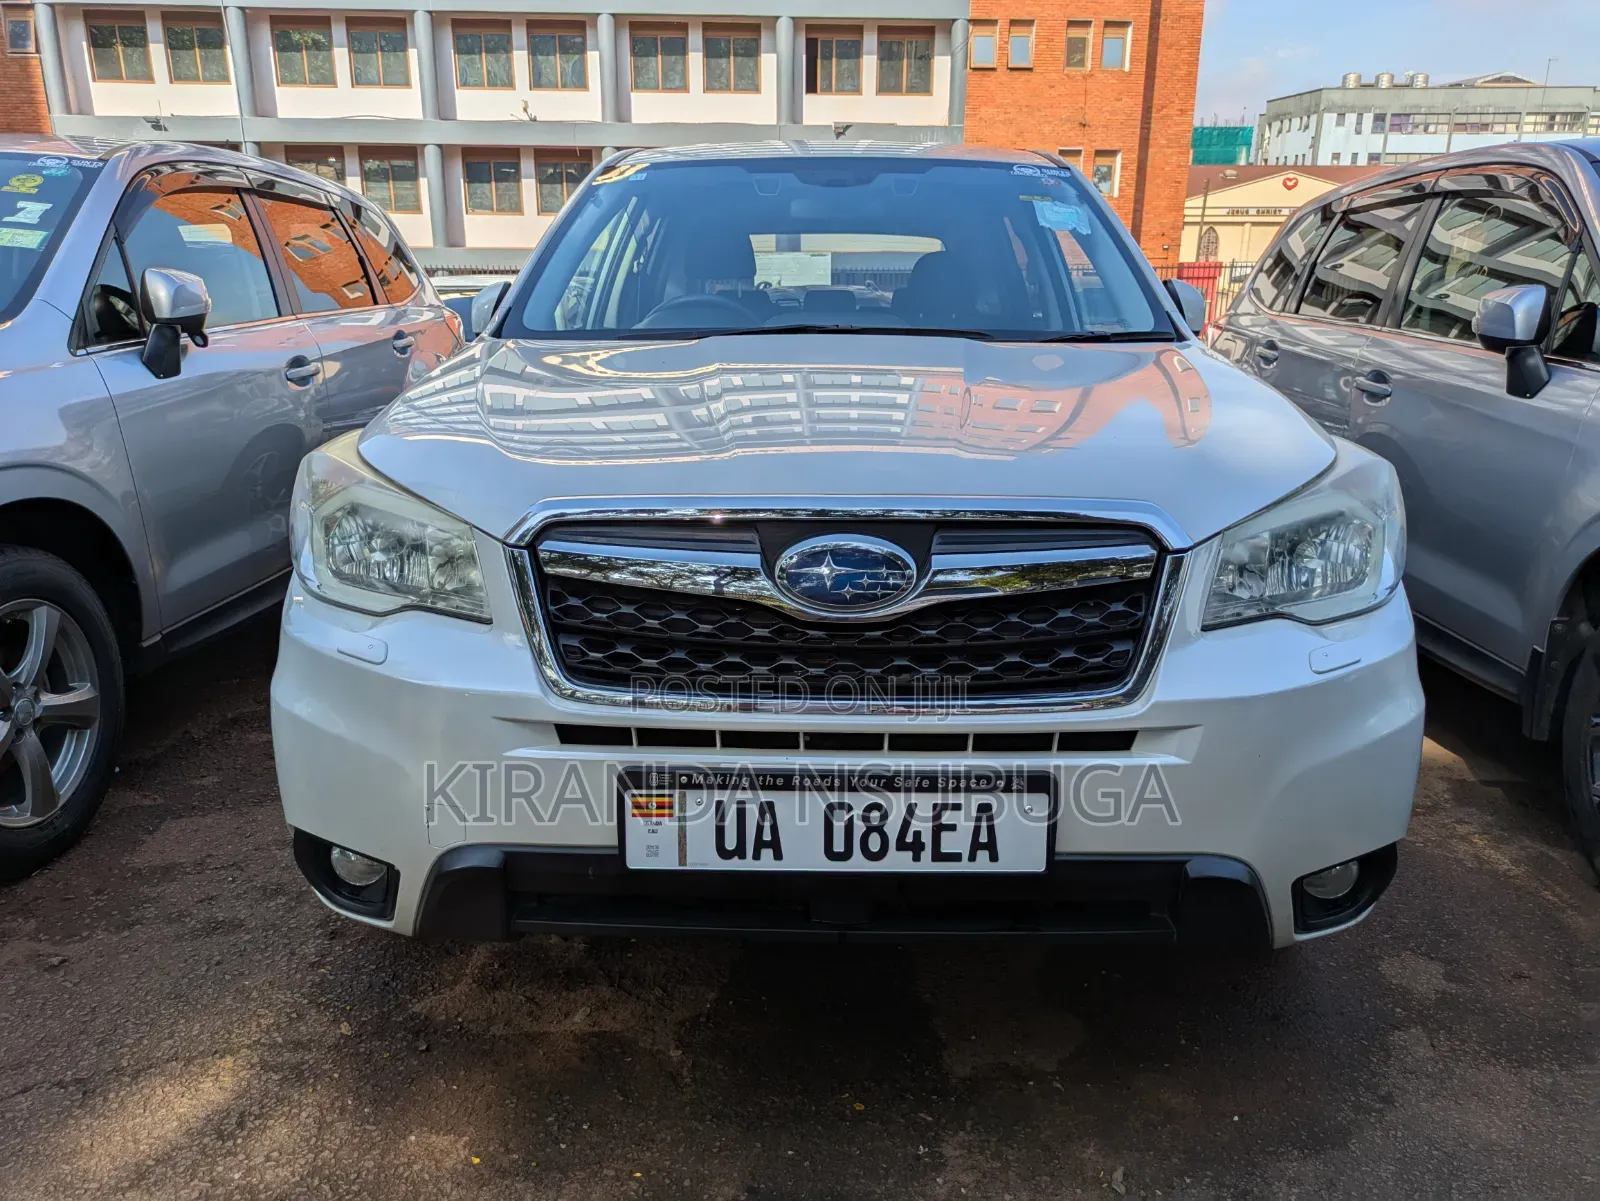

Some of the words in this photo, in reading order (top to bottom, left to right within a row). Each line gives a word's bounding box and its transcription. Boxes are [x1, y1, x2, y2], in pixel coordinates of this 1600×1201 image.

[691, 774, 750, 787] Making
[758, 774, 784, 786] the
[792, 776, 841, 787] Roads
[850, 776, 887, 787] Your
[893, 776, 930, 788] Safe
[937, 777, 988, 790] Space
[715, 800, 784, 861] UA
[824, 802, 999, 863] 084EA
